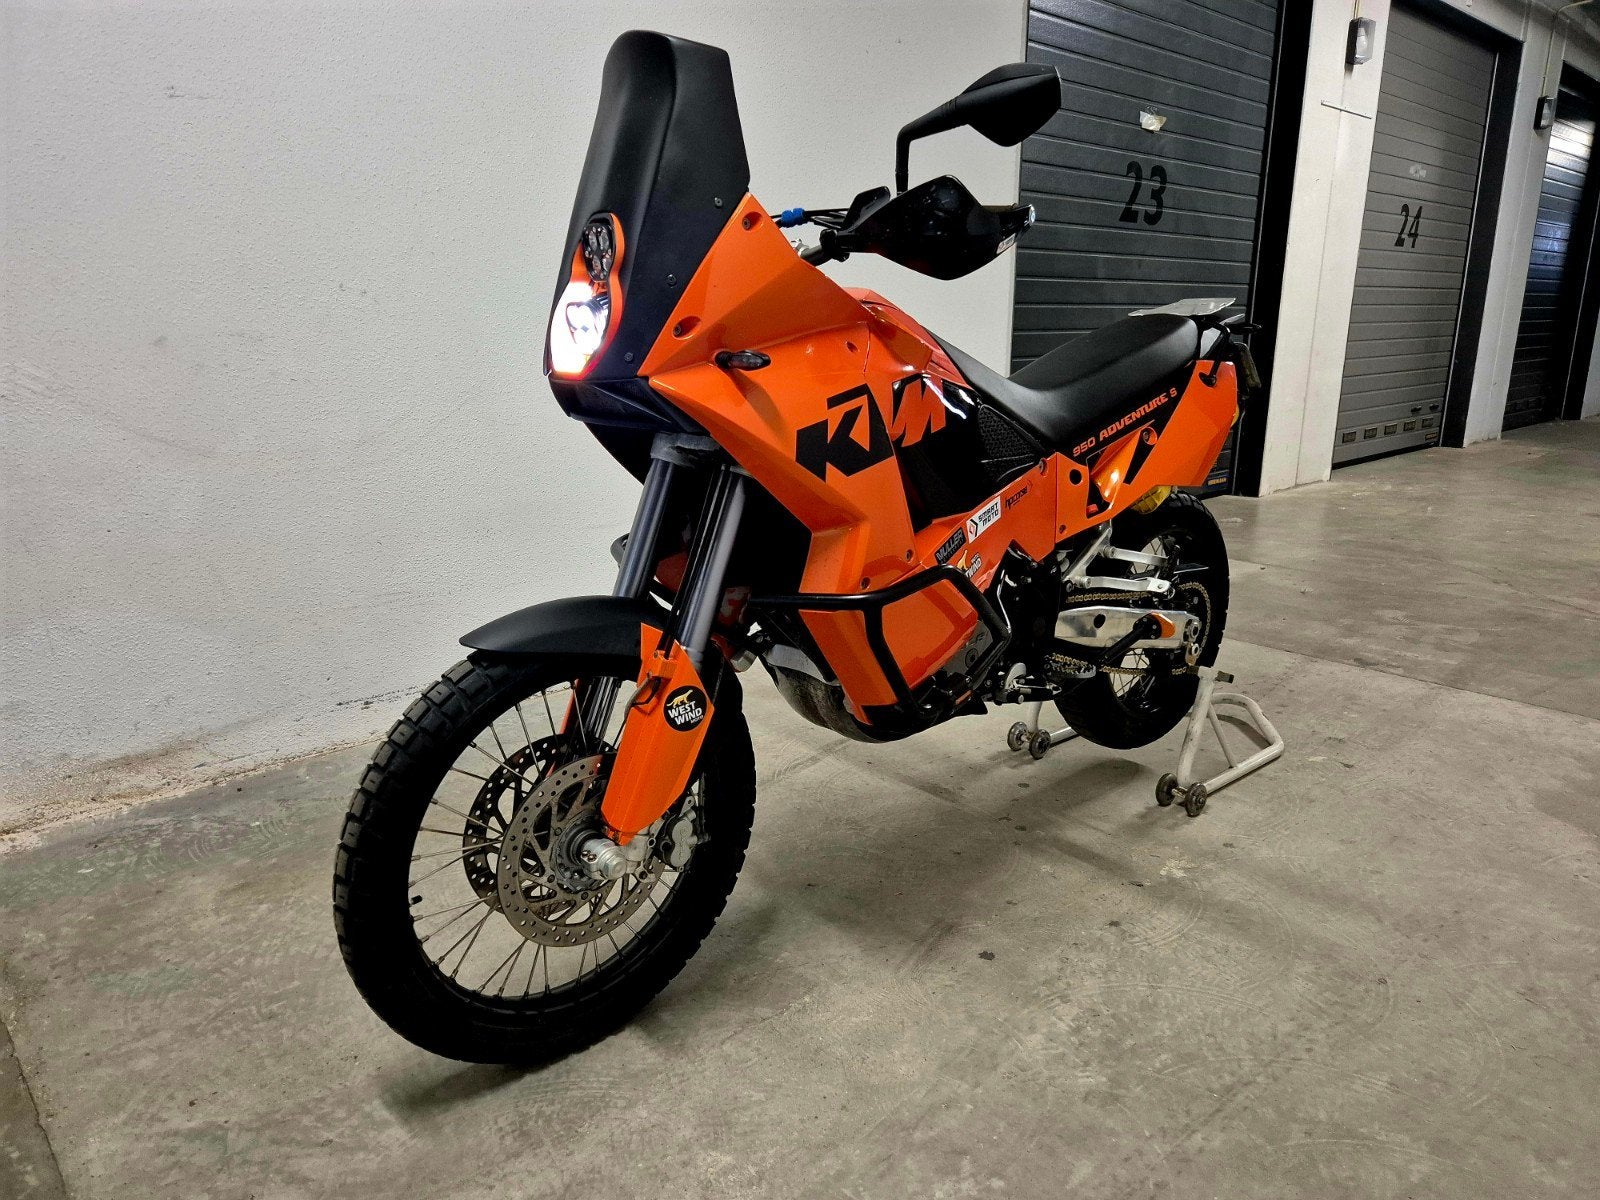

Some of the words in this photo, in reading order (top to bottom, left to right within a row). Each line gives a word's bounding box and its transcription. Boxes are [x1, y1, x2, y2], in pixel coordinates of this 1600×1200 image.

[1119, 161, 1167, 225] 23
[1394, 204, 1422, 248] 24
[795, 374, 946, 483] KTM
[1072, 436, 1096, 457] 950
[1099, 393, 1169, 442] ADVENTURE
[1170, 387, 1178, 398] S
[982, 509, 999, 526] MOTO
[667, 700, 696, 719] WEST
[674, 707, 703, 726] WIND
